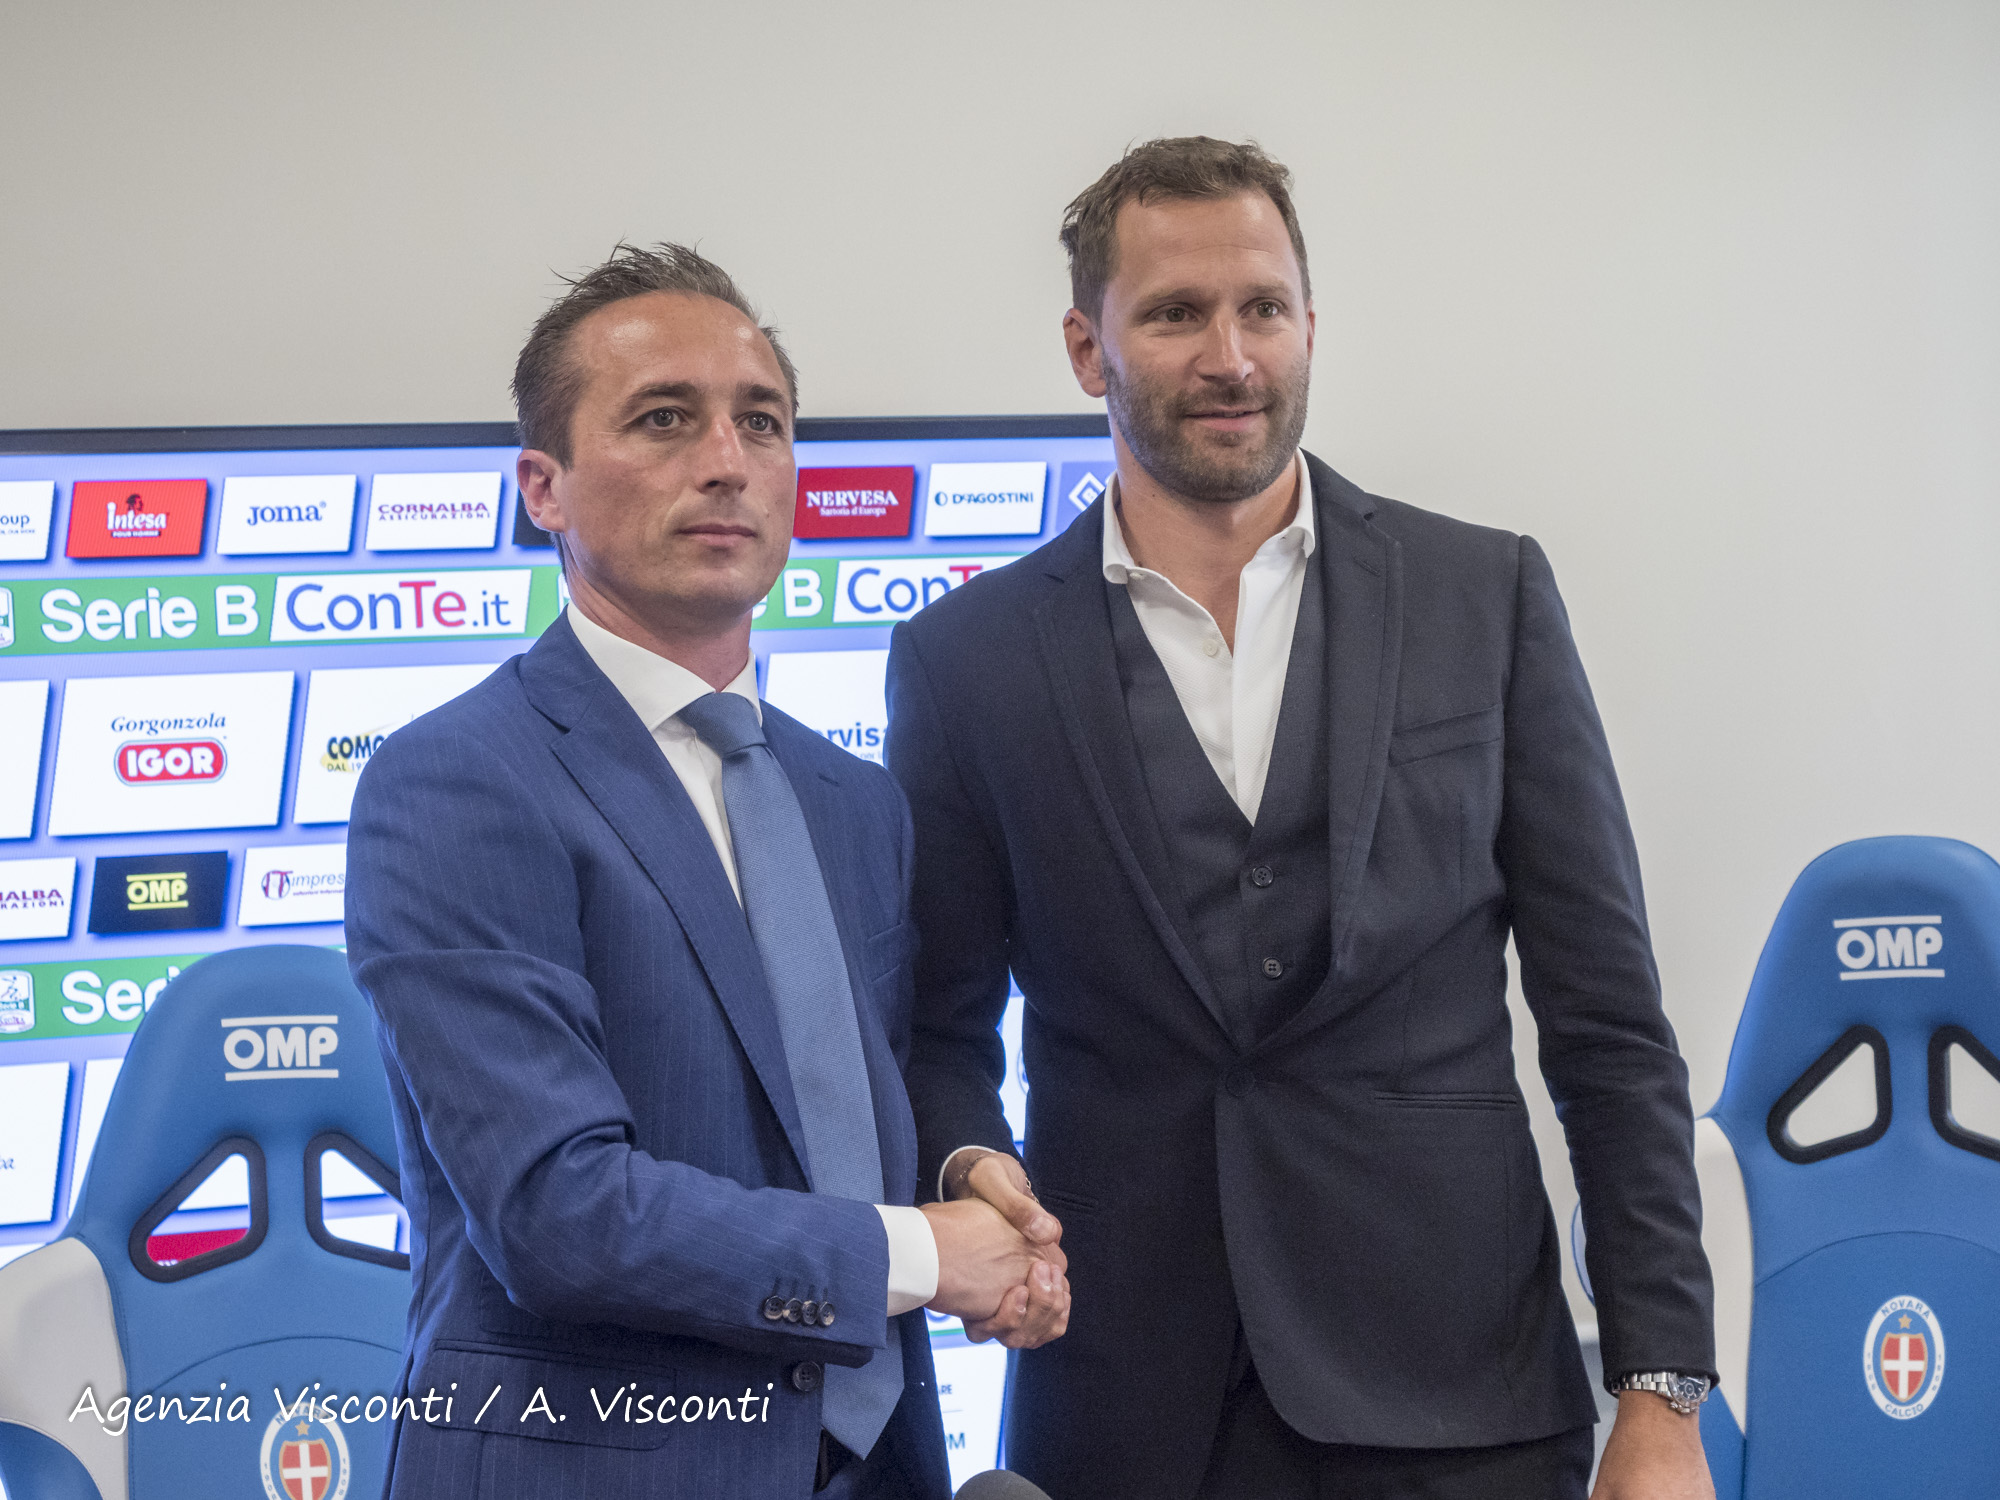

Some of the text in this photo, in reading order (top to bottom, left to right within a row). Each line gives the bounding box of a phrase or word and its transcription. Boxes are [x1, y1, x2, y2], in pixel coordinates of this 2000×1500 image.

[378, 502, 488, 514] CORNALBA
[806, 489, 899, 508] NERVESA
[107, 501, 167, 530] Intesa
[783, 568, 824, 618] B
[847, 565, 983, 614] ConT
[41, 585, 260, 643] Serie B
[286, 580, 512, 632] ConTe.it
[111, 712, 226, 736] Gorgonzola
[815, 722, 887, 747] rvis
[126, 746, 215, 778] IGOR
[327, 762, 347, 772] DAL
[127, 879, 188, 904] OMP
[1837, 926, 1943, 970] OMP
[61, 966, 180, 1025] Ser
[223, 1026, 338, 1070] OMP
[1881, 1299, 1931, 1321] NOVARA
[1885, 1403, 1925, 1418] CALCIO
